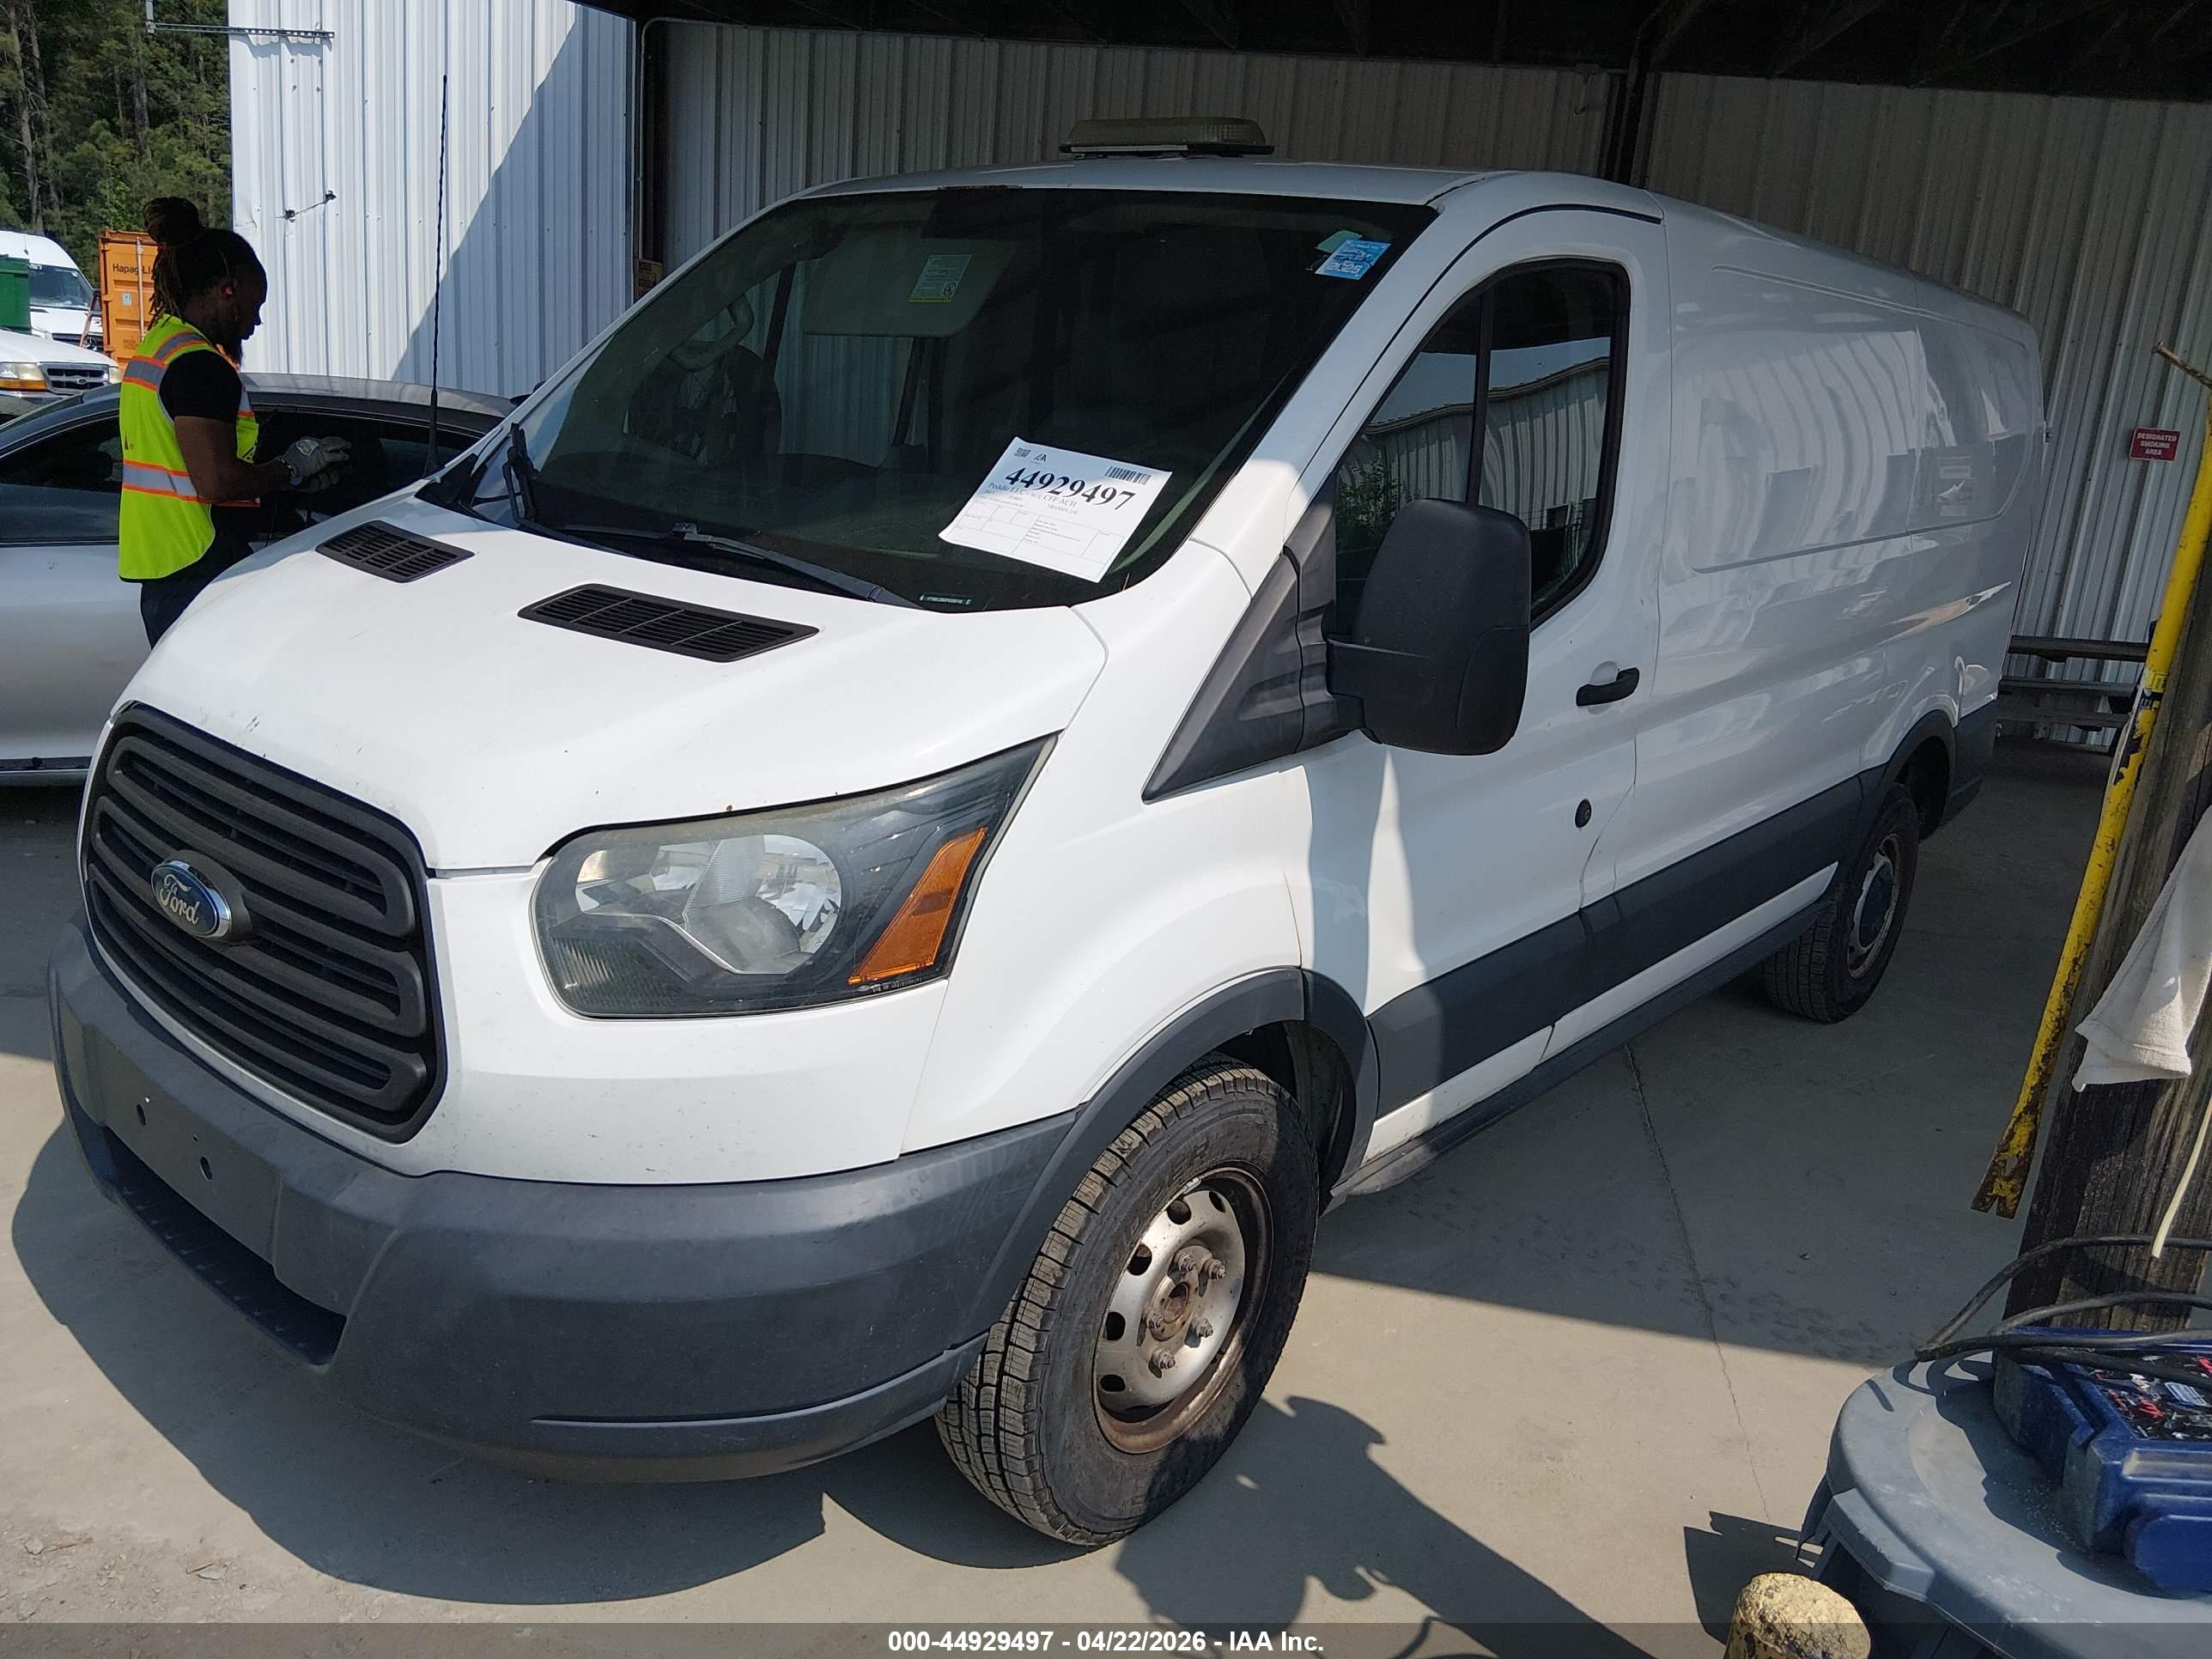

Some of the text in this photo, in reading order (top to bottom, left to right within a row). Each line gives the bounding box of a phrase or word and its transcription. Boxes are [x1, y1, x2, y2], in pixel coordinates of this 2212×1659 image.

[112, 263, 154, 276] HapagLl
[2137, 433, 2177, 441] DESIGNATED
[1005, 467, 1137, 510] 44929497
[160, 873, 200, 926] Ford
